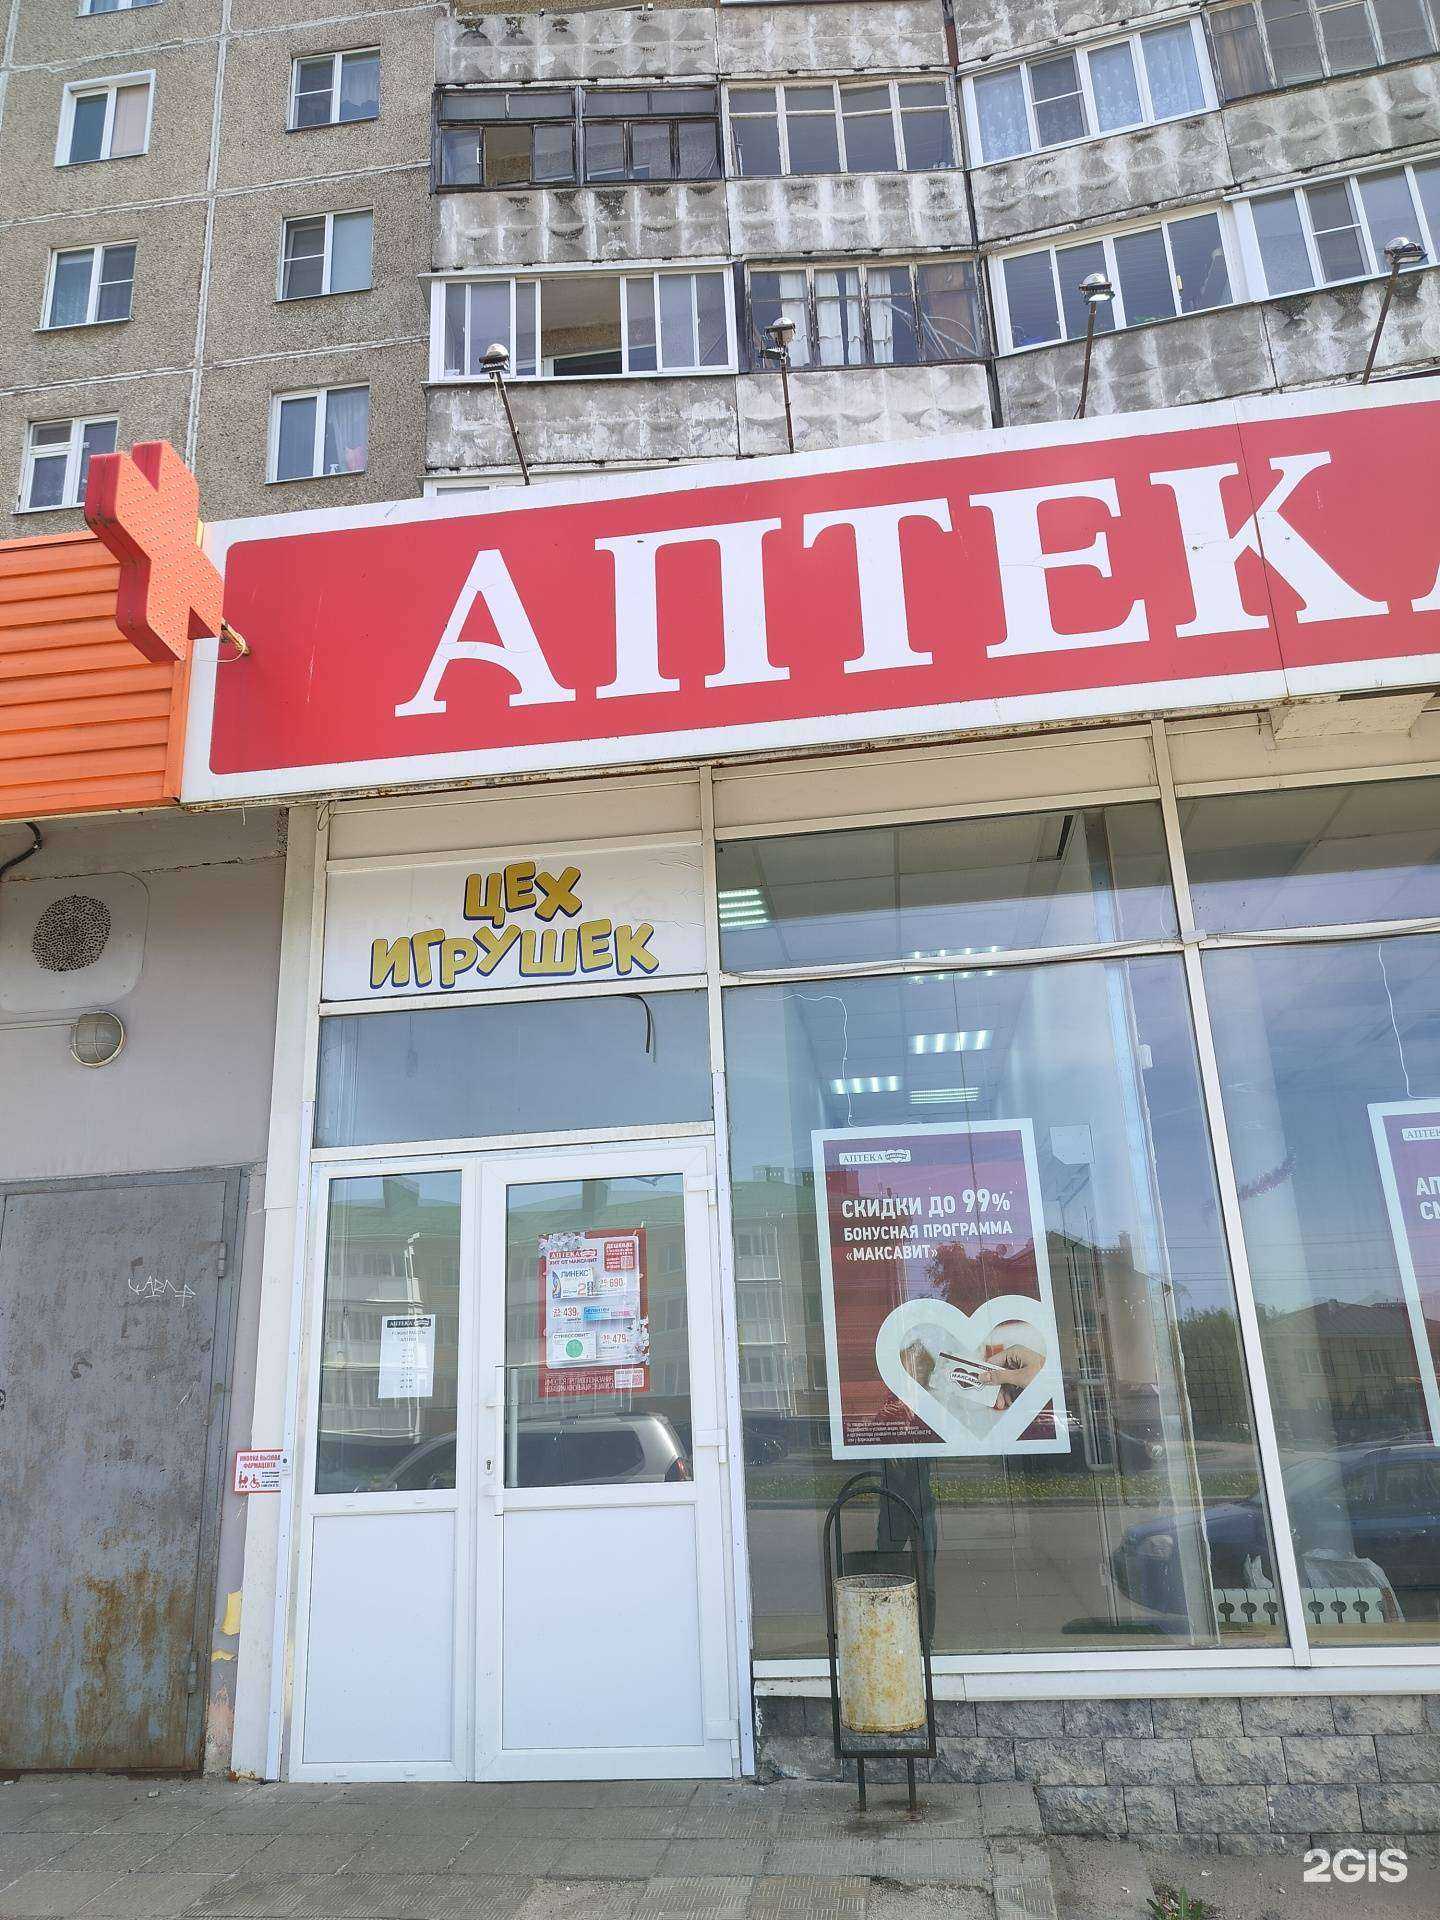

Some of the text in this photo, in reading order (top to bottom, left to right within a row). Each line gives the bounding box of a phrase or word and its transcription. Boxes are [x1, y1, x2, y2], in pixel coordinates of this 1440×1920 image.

[394, 450, 1440, 719] АПТЕК
[463, 861, 582, 929] ЦЕХ
[370, 918, 660, 989] ИГРУШЕК
[842, 1152, 883, 1164] АПТЕКА
[841, 1196, 922, 1220] СКИДКИ
[928, 1195, 956, 1217] ДО
[843, 1220, 1013, 1242] БОНУСНАЯ ПРОГРАММА
[551, 1250, 580, 1260] АПТЕКА
[845, 1244, 938, 1261] «МАКСАВИТ»
[560, 1269, 588, 1279] ЛИНЕКС
